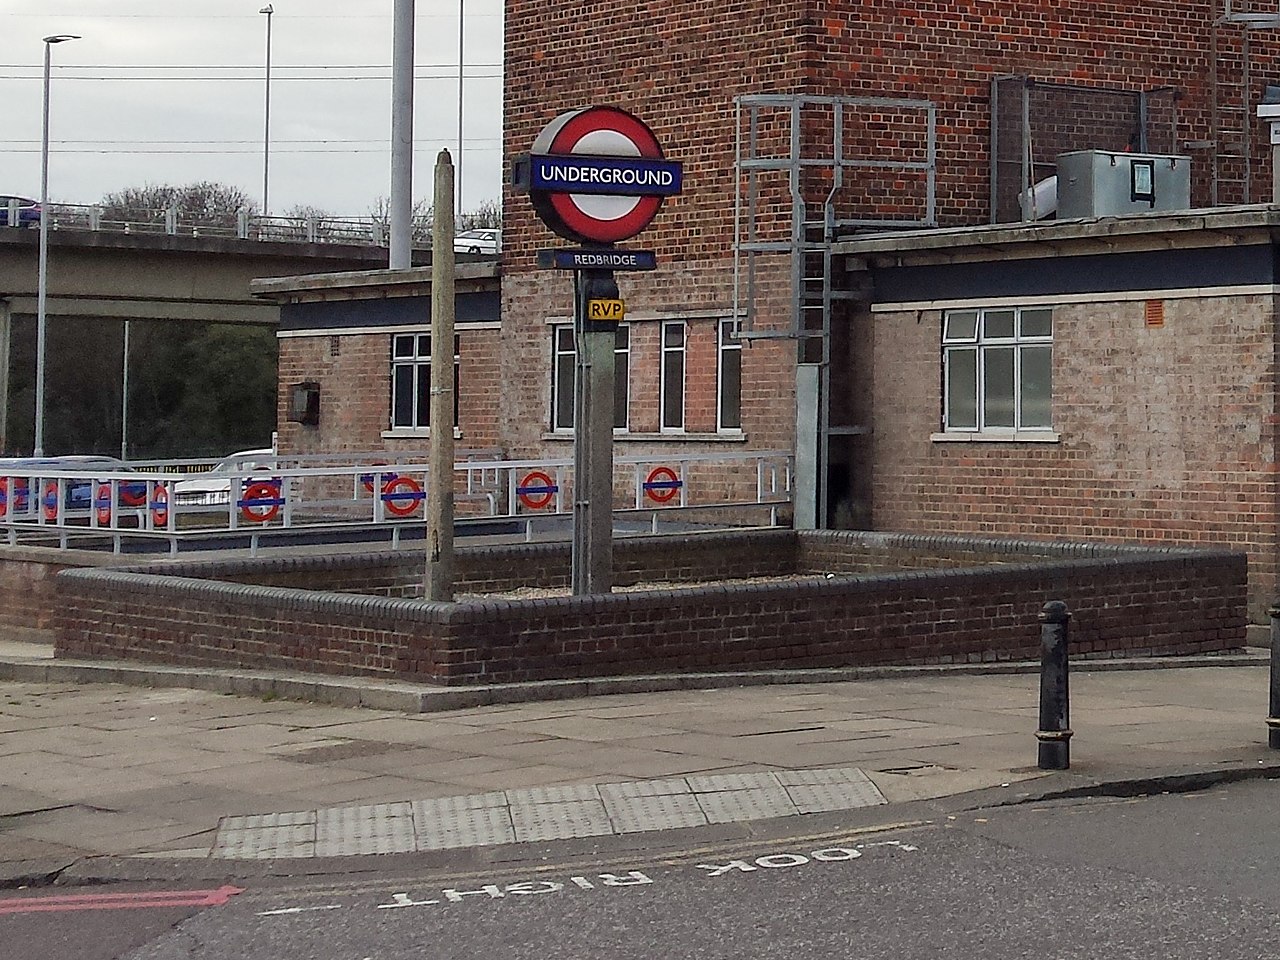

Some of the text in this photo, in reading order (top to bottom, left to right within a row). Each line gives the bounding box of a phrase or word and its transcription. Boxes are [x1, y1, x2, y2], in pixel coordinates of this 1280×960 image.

[541, 165, 673, 186] UNDERGROUND
[574, 254, 637, 266] REDBRIDGE
[592, 303, 622, 317] RVP
[377, 840, 918, 909] LOOK RIGHT
